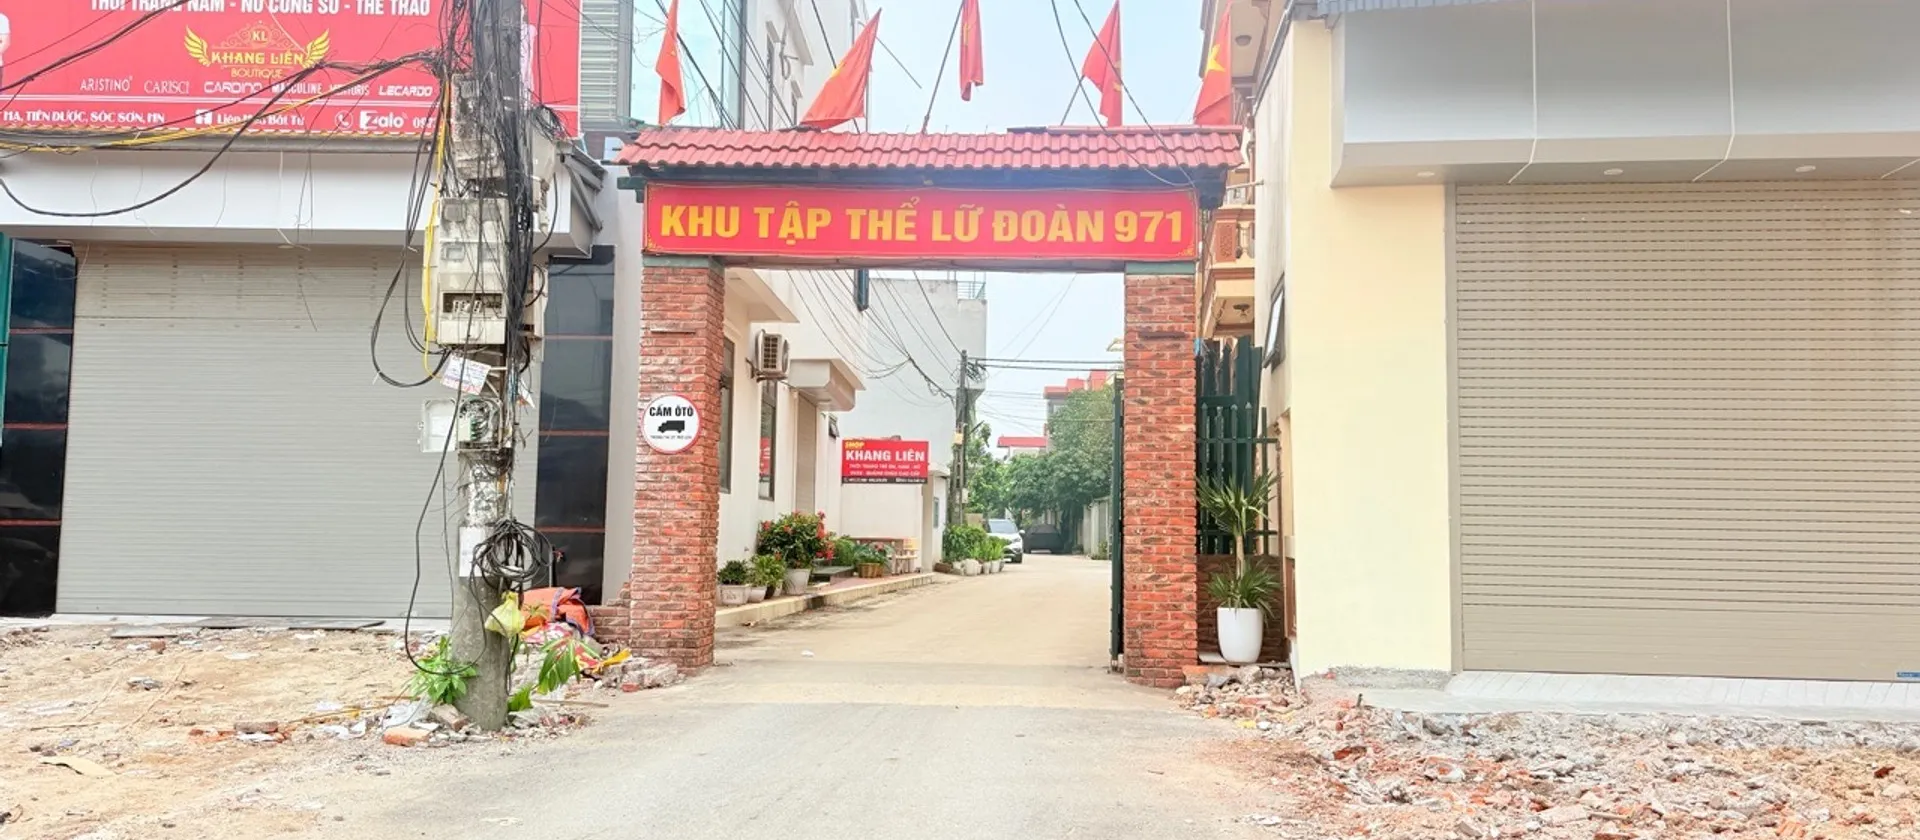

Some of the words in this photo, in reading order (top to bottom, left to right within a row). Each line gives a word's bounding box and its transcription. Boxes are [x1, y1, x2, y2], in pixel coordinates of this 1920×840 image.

[252, 31, 268, 41] KL
[211, 52, 265, 64] KHANG
[231, 67, 283, 79] BOUTIQUE
[144, 81, 190, 95] CARISCI
[378, 86, 433, 98] LECARDO
[360, 110, 404, 129] Zalo
[661, 205, 740, 239] KHU
[754, 200, 832, 246] TẬP
[846, 196, 921, 242] THỂ
[931, 204, 985, 242] LỮ
[992, 203, 1105, 242] ĐOÀN
[1114, 210, 1182, 242] 971
[649, 403, 672, 417] CẤM
[845, 449, 891, 461] KHANG
[895, 448, 925, 462] LIÊN
